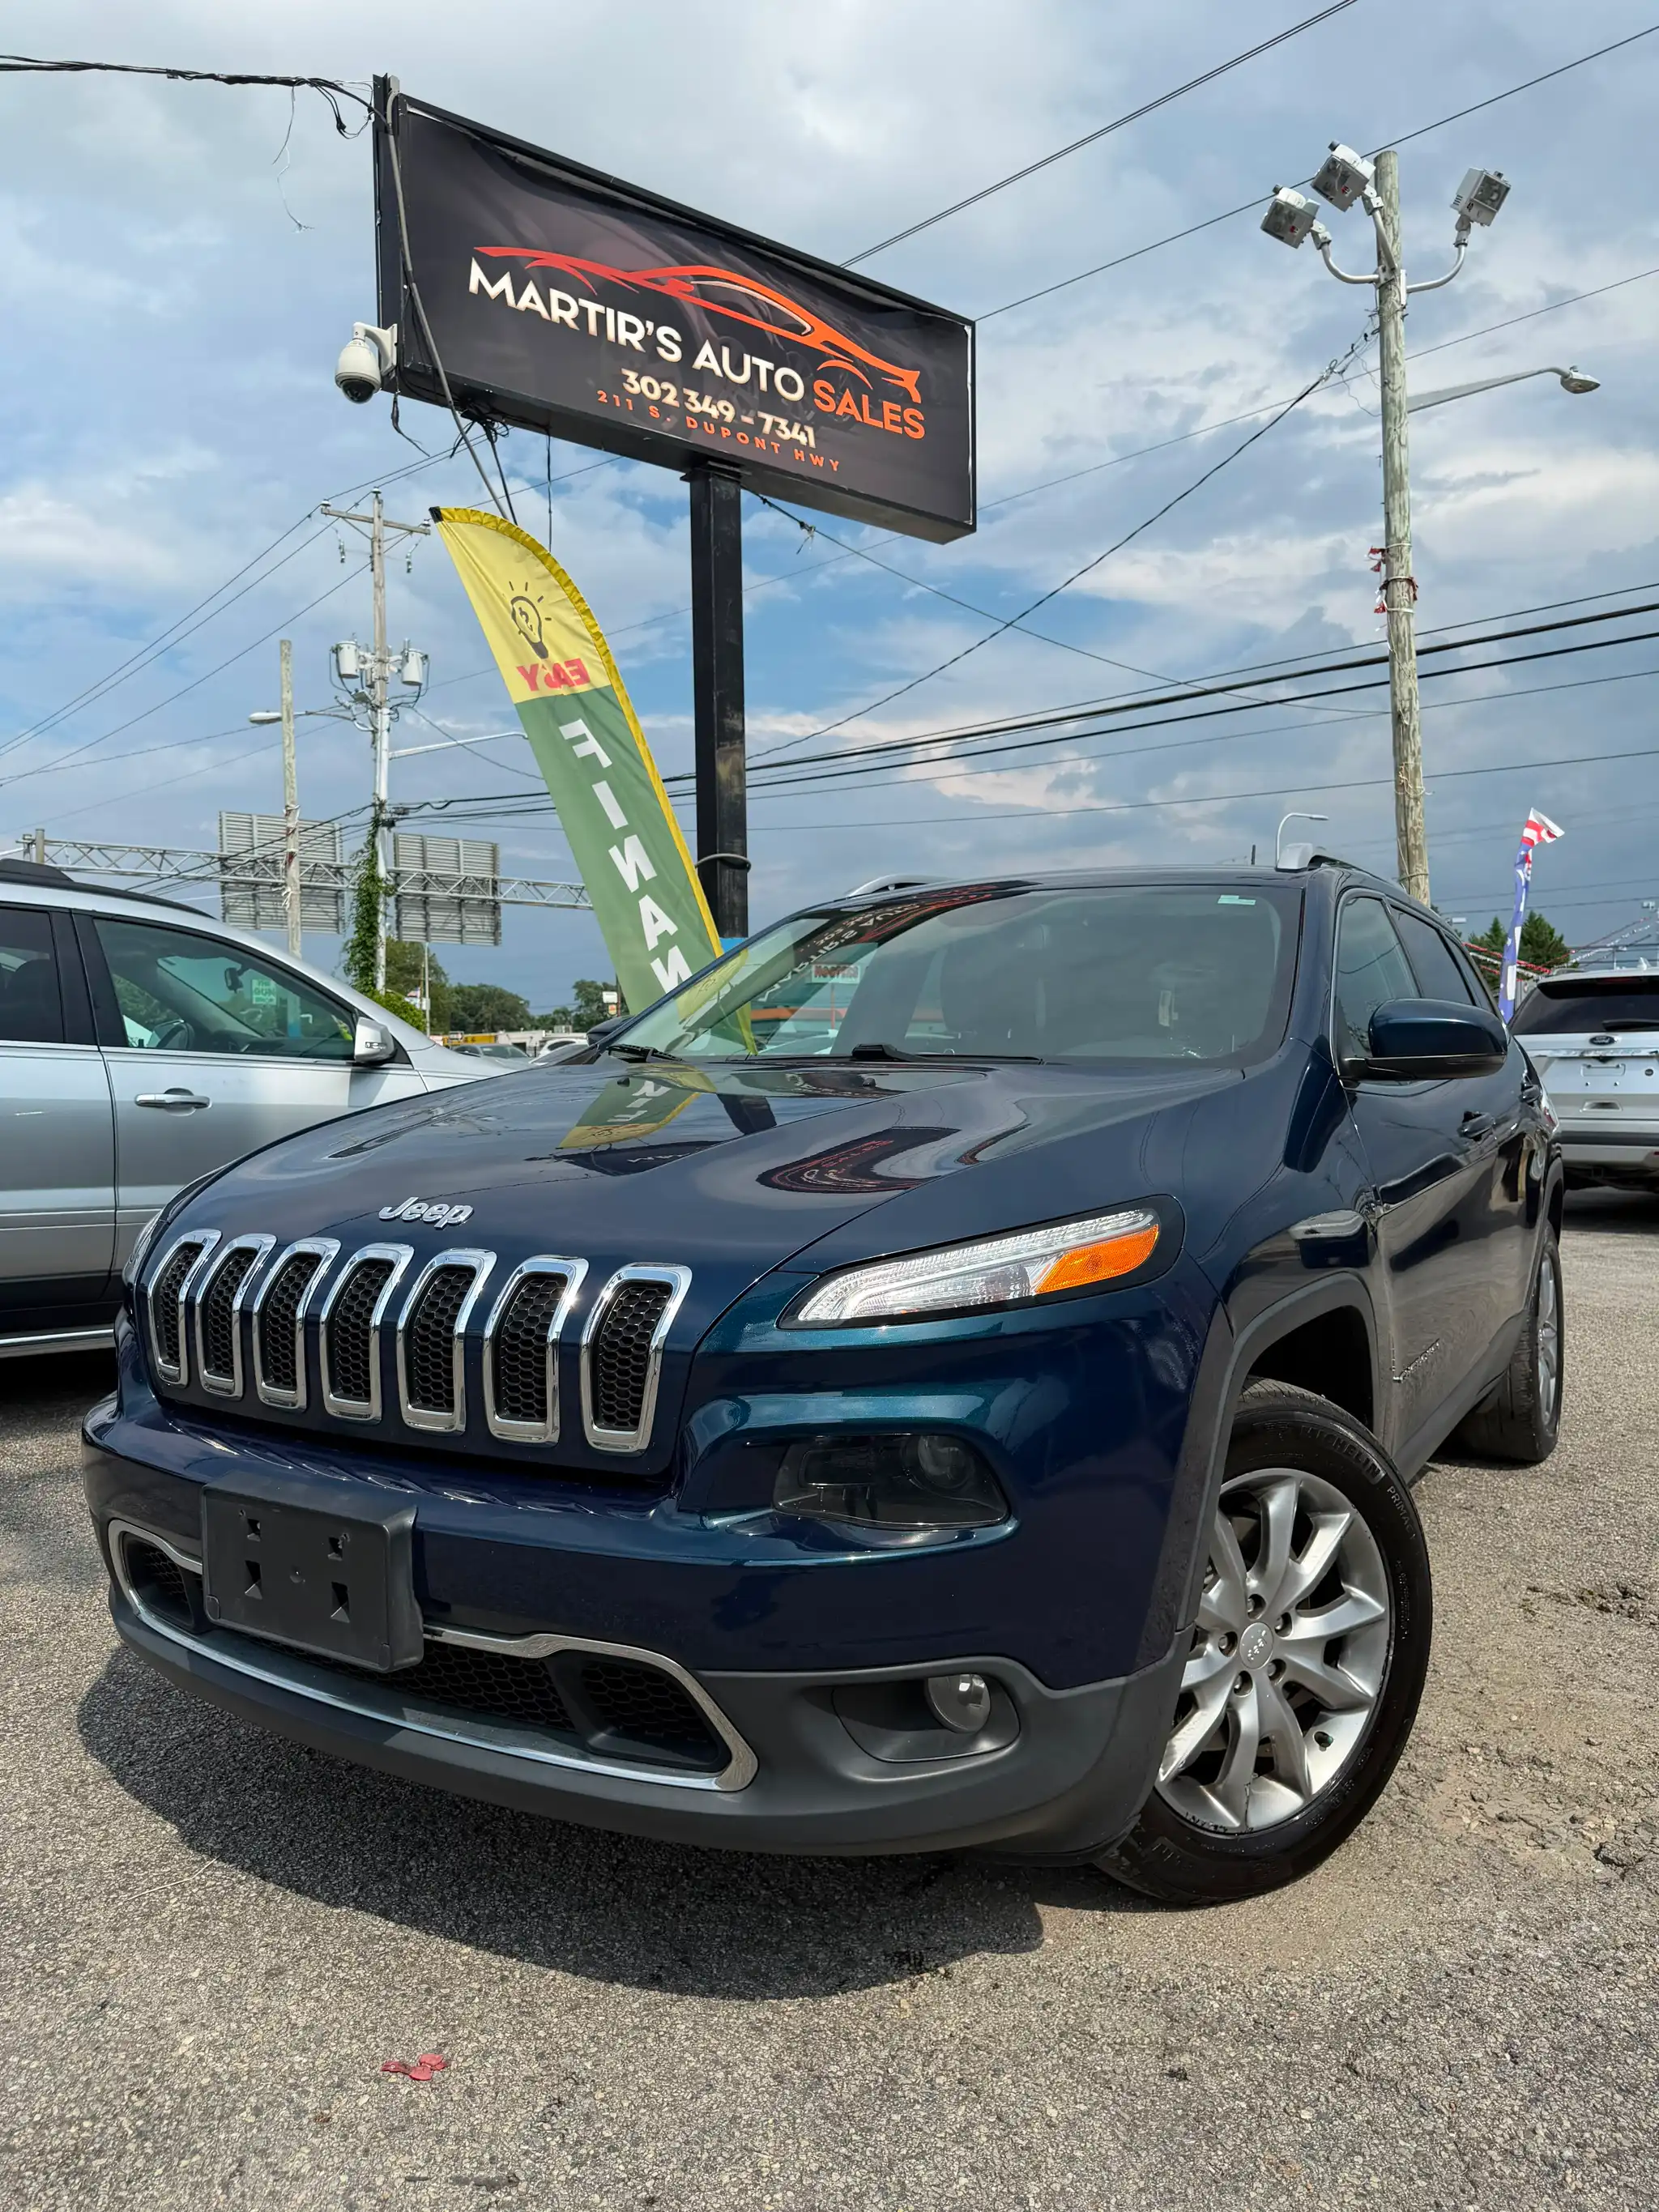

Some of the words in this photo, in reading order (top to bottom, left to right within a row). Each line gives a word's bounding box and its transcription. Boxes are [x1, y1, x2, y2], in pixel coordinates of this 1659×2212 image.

[468, 256, 682, 363] MARTIR'S
[692, 339, 804, 402] AUTO
[812, 379, 925, 439] SALES
[596, 390, 633, 411] 211
[648, 405, 672, 422] S.
[685, 416, 780, 454] DUPONT
[793, 448, 839, 472] HWY
[621, 368, 680, 408] 302
[682, 387, 736, 424] 349
[757, 410, 816, 449] 7341
[378, 1196, 474, 1230] Jeep
